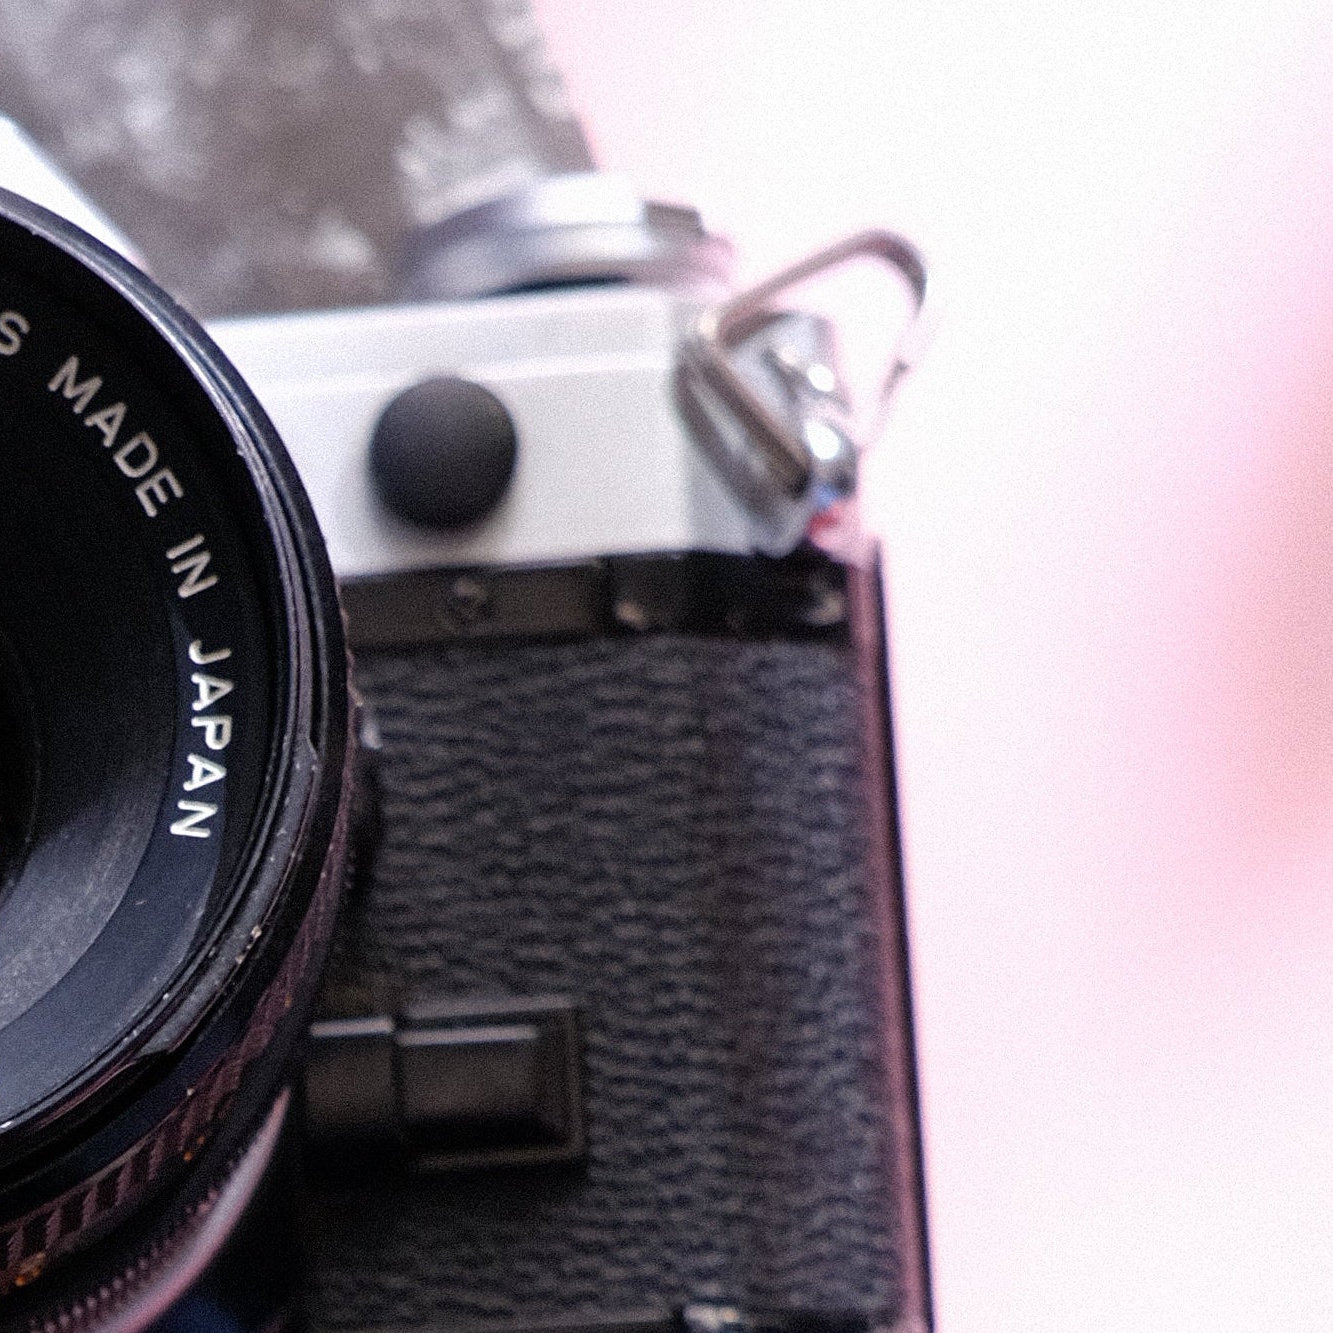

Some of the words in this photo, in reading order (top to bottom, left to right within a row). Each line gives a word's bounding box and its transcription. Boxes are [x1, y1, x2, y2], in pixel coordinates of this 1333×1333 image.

[48, 356, 183, 518] MADE
[165, 535, 220, 599] IN
[169, 640, 233, 840] JAPAN
